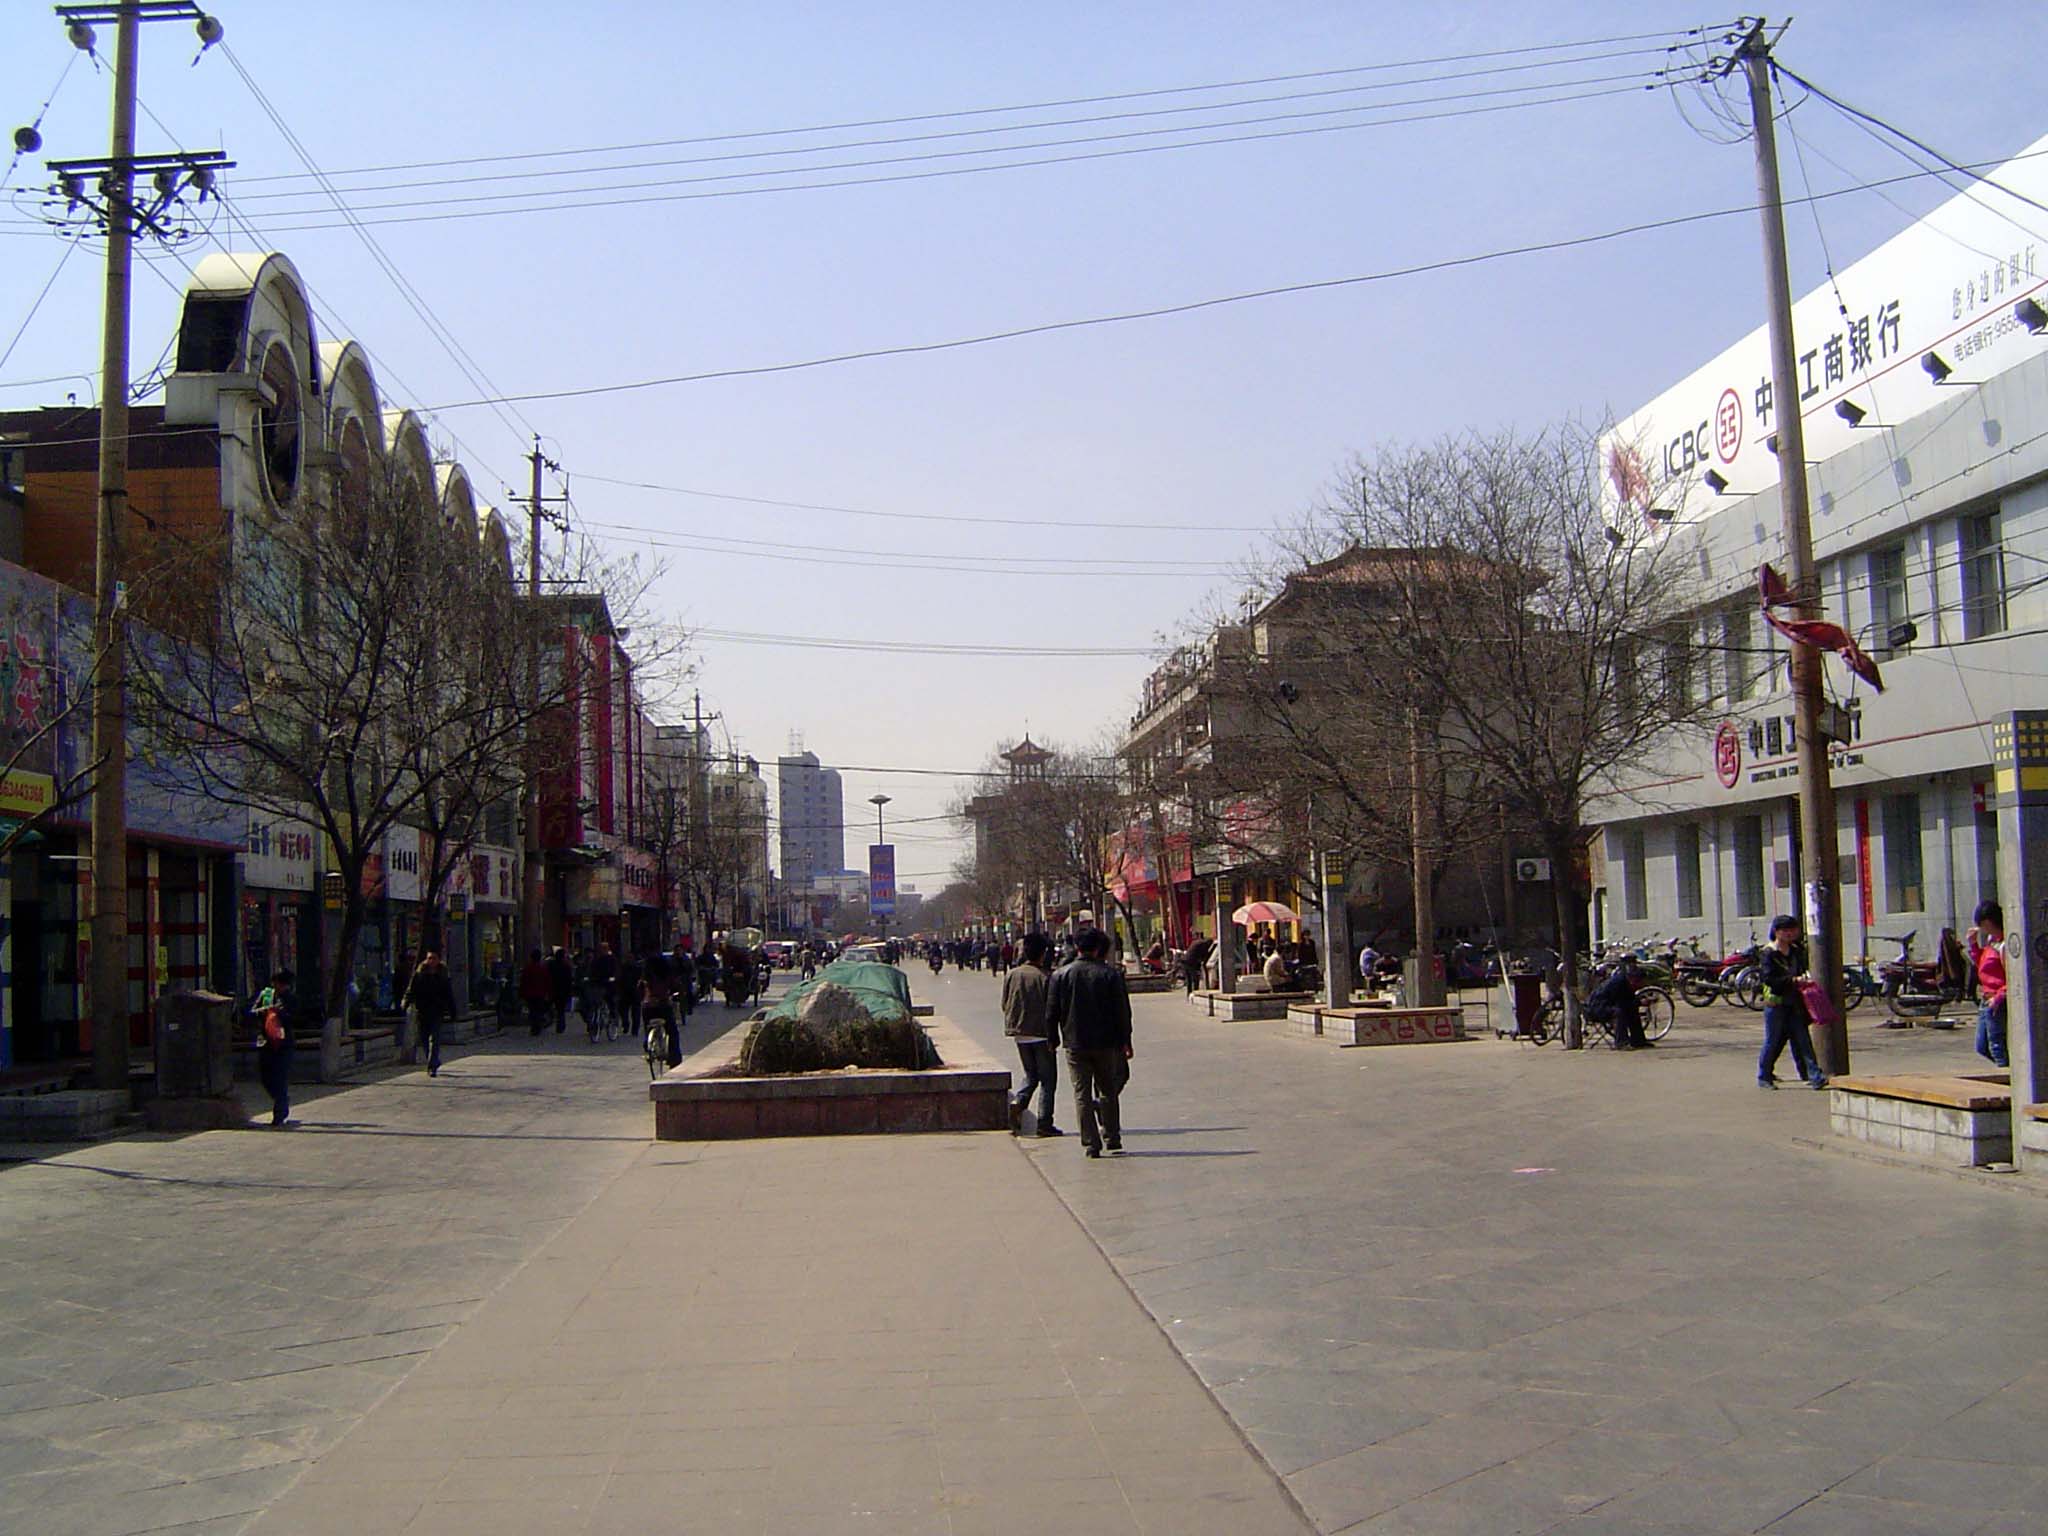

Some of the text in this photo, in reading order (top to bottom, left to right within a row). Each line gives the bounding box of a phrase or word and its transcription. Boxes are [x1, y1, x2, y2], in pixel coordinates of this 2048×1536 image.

[1754, 299, 1901, 427] 中工商银行
[1663, 420, 1710, 482] ICBC
